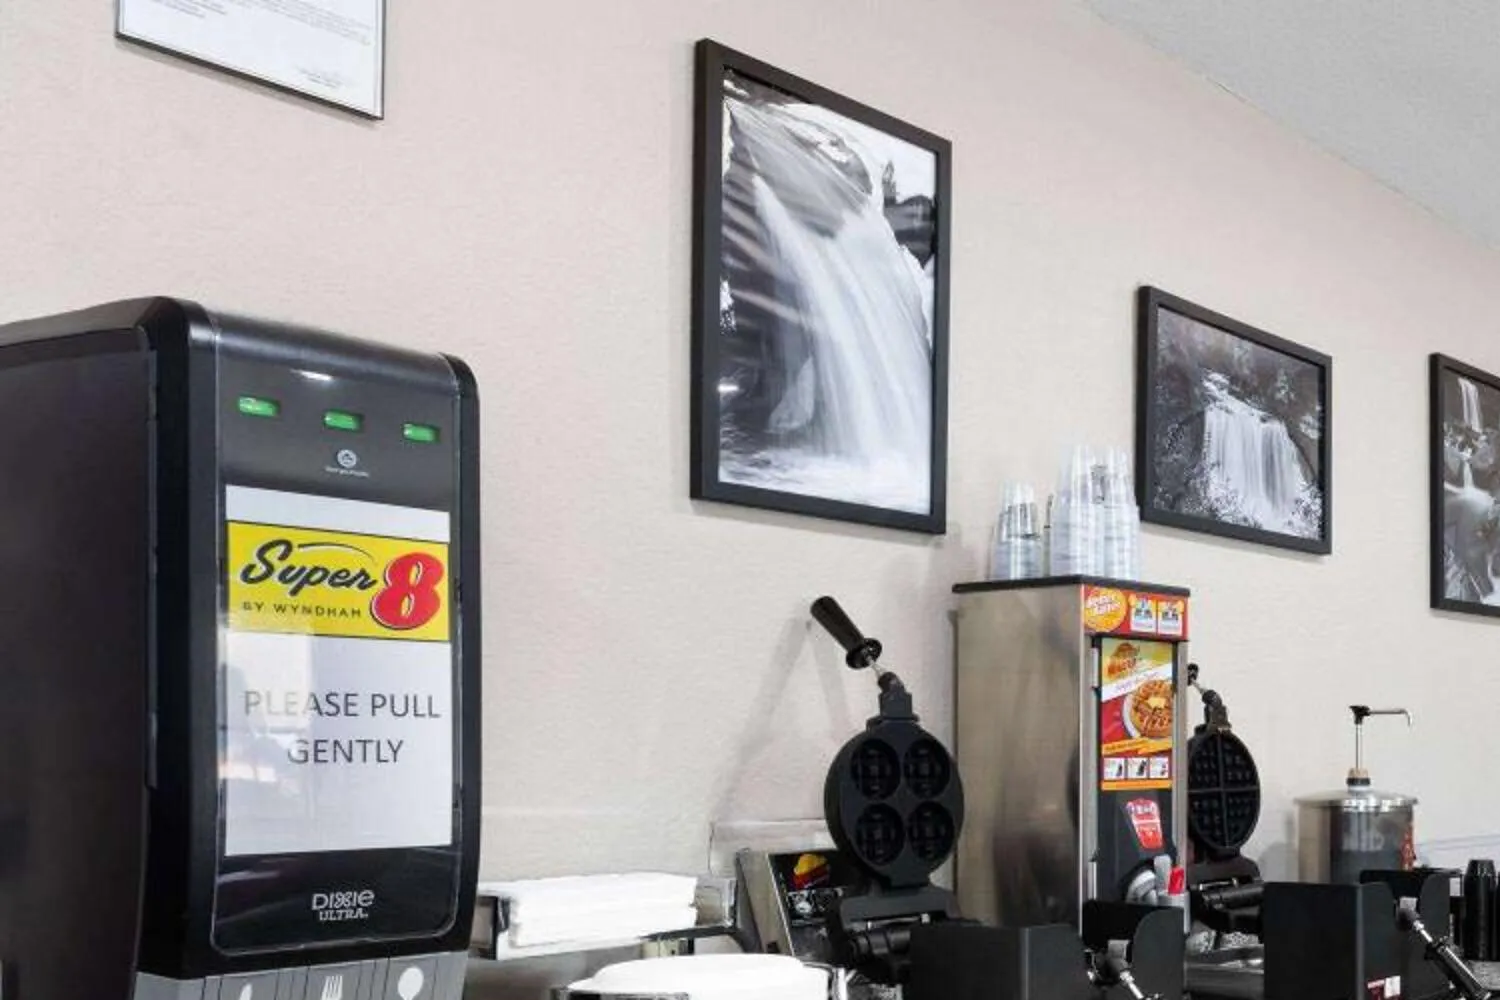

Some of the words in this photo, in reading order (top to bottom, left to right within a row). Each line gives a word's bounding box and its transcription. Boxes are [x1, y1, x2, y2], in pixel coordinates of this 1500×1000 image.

[240, 538, 377, 597] Super
[370, 552, 445, 630] 8
[243, 602, 264, 613] BY
[273, 603, 362, 618] WYNDHAM
[244, 690, 360, 717] PLEASE
[371, 693, 442, 719] PULL
[287, 738, 404, 764] GENTLY
